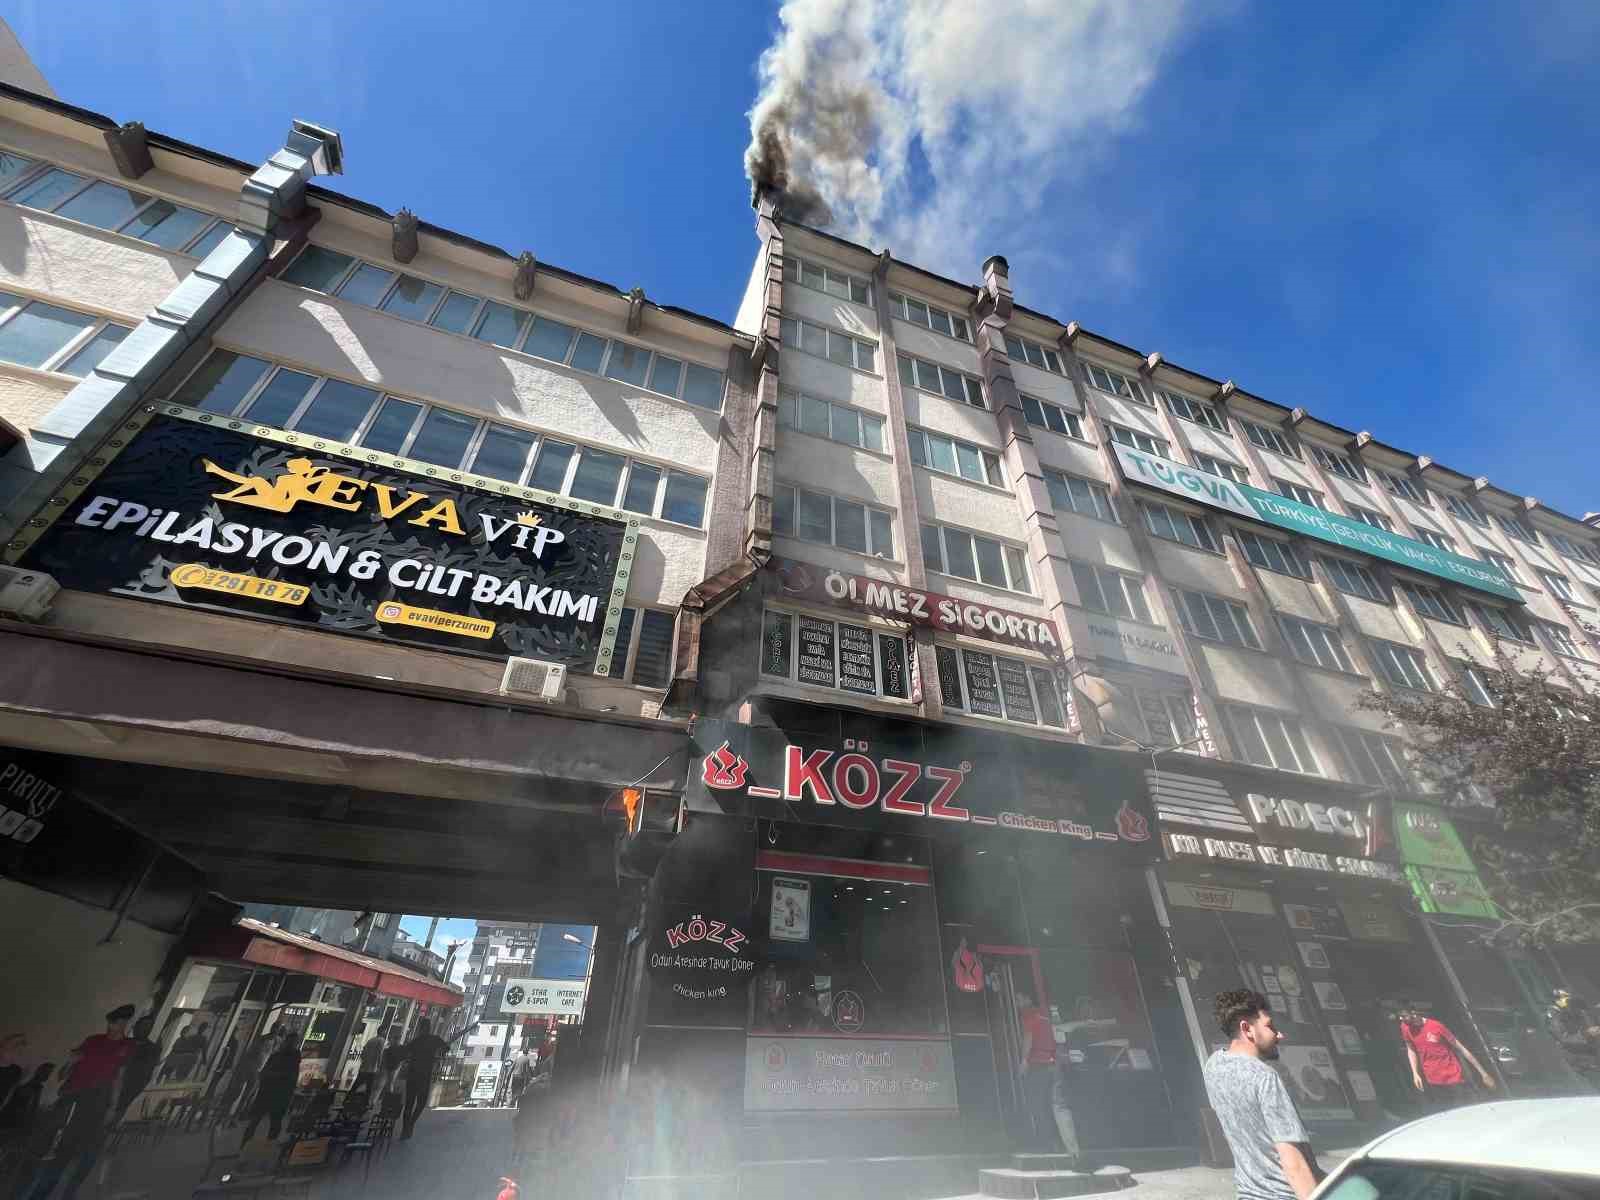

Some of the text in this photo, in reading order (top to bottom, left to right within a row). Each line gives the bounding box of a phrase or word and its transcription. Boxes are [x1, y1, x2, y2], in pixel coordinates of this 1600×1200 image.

[320, 473, 467, 536] EVA
[348, 550, 382, 580] &
[471, 573, 599, 623] BAKIMI
[408, 610, 490, 634] evaviperzurum
[783, 739, 970, 821] KÖZZ
[1000, 811, 1093, 840] Chicken King
[666, 913, 746, 954] KÖZZ
